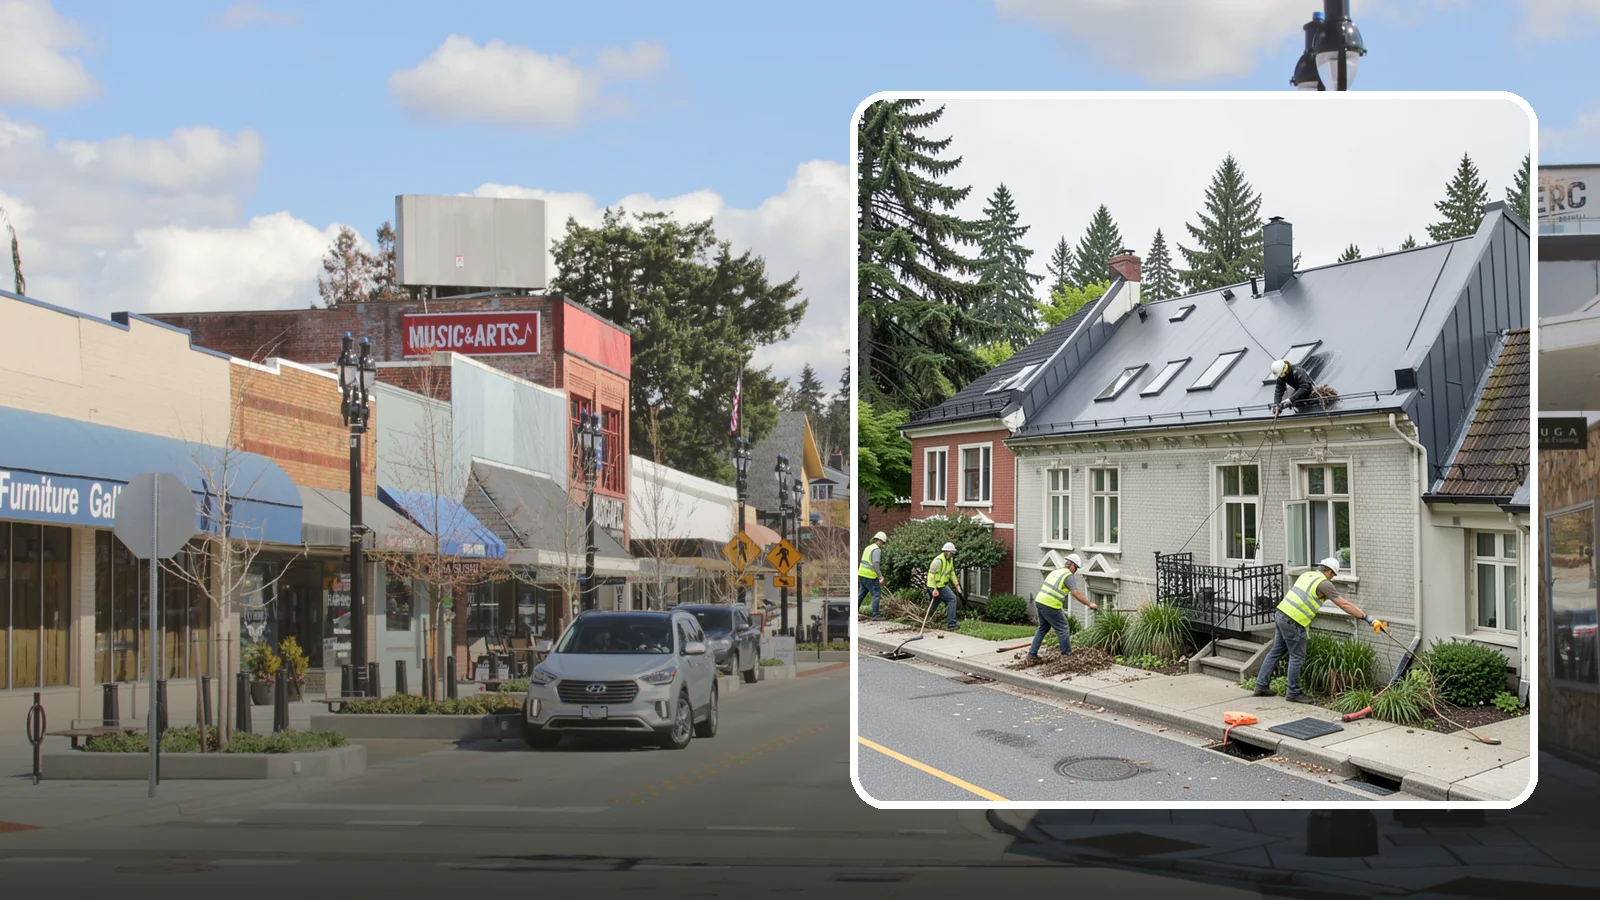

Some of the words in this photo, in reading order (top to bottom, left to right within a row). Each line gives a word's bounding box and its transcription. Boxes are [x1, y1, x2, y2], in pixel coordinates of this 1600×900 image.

[408, 323, 520, 349] MUSIC&ARTS
[1540, 427, 1577, 436] UGA
[0, 471, 79, 515] Furniture
[89, 482, 122, 519] Gal
